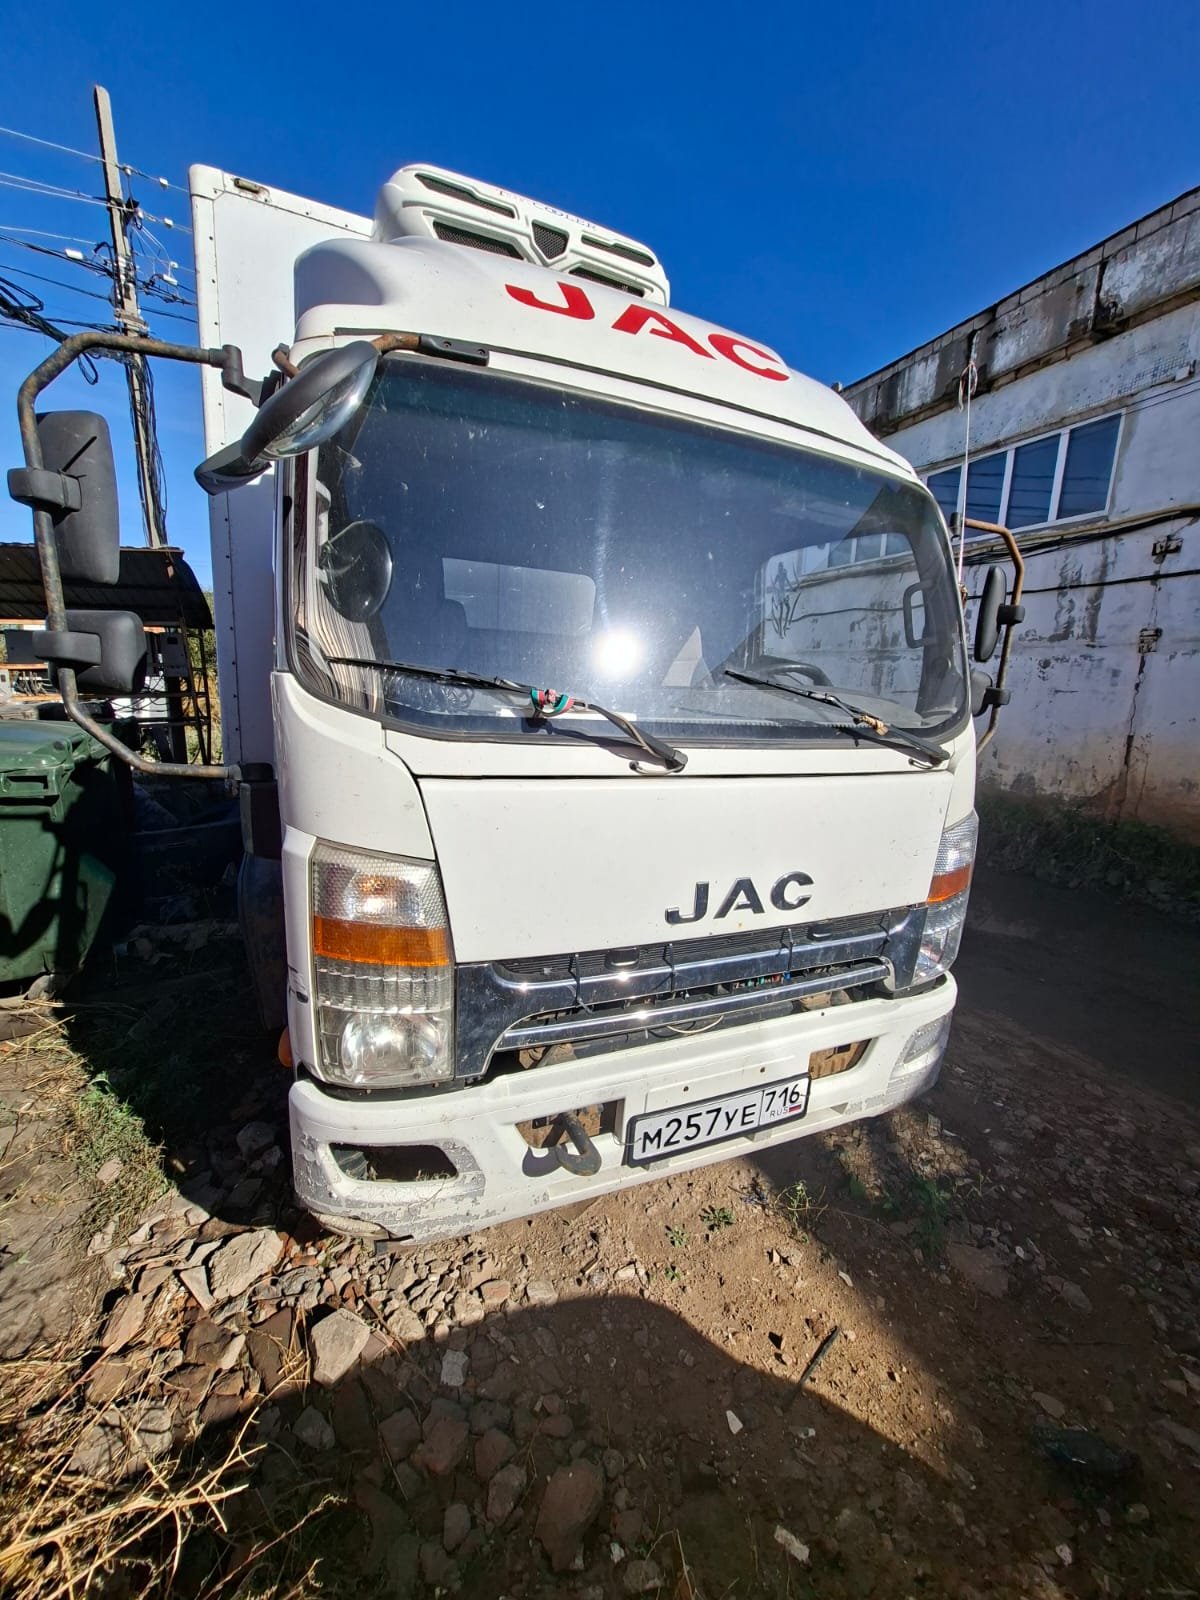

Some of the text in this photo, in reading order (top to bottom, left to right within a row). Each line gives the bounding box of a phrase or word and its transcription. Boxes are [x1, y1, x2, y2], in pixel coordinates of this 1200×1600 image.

[505, 281, 790, 381] JAC
[664, 871, 814, 925] JAC
[765, 1083, 800, 1113] 716
[769, 1106, 789, 1118] RUS
